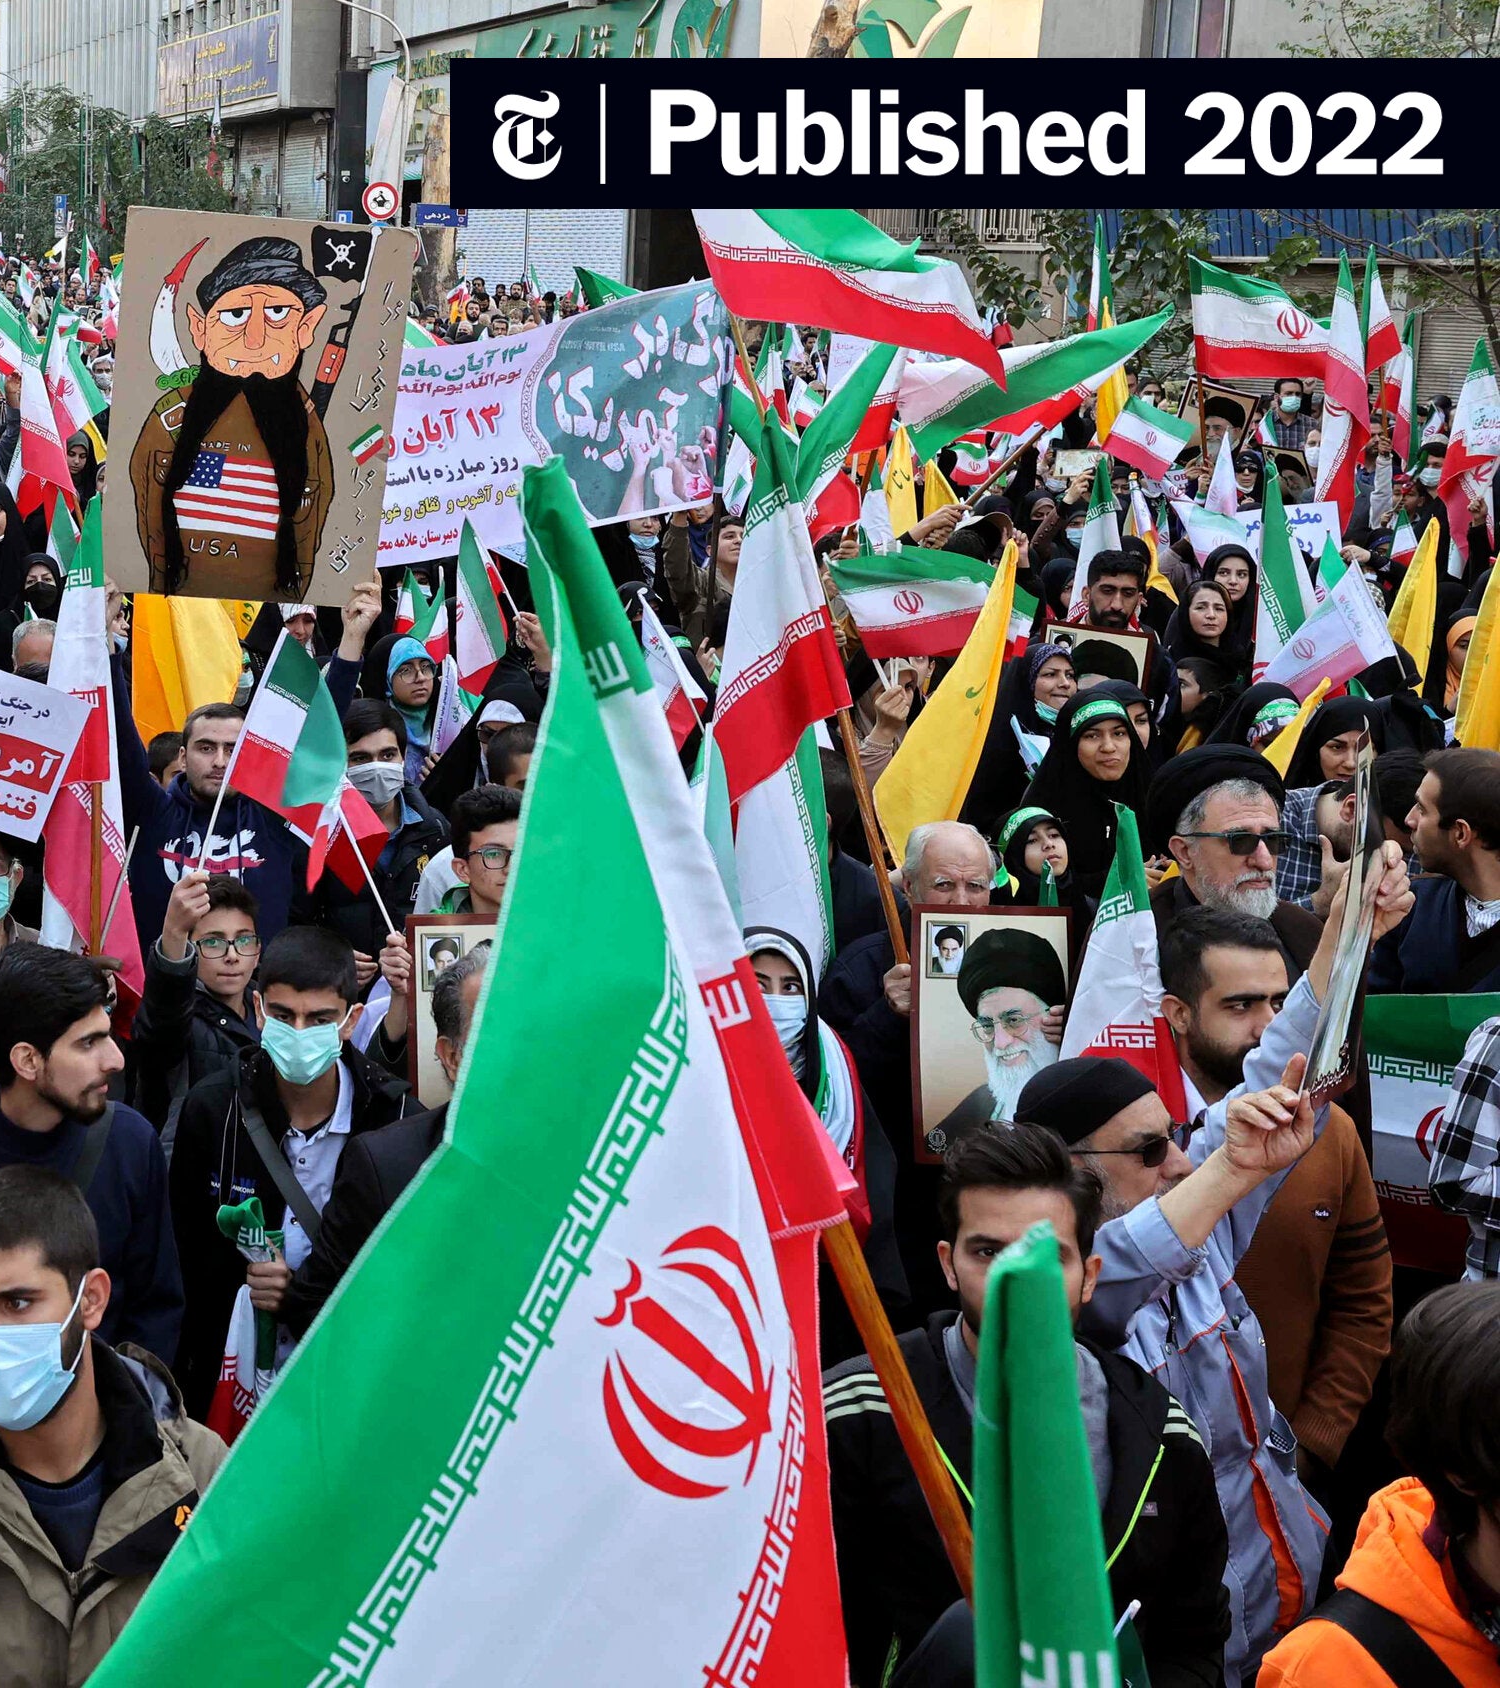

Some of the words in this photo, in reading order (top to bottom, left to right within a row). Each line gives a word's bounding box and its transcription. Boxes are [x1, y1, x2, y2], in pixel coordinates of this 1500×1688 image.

[400, 358, 442, 378] ماه
[443, 348, 501, 381] آبان
[402, 407, 457, 456] آبان
[200, 441, 231, 452] MADE
[237, 443, 252, 452] IN
[434, 458, 485, 483] مبارزه
[490, 455, 519, 474] روز
[385, 468, 416, 487] است
[418, 466, 432, 484] با
[456, 485, 493, 512] آشوب
[1287, 508, 1323, 527] مطی
[188, 536, 239, 560] USA
[377, 538, 394, 551] مح
[394, 533, 418, 548] علامه
[420, 528, 459, 549] دبیرستان
[0, 694, 34, 712] جنگ
[32, 707, 51, 719] در
